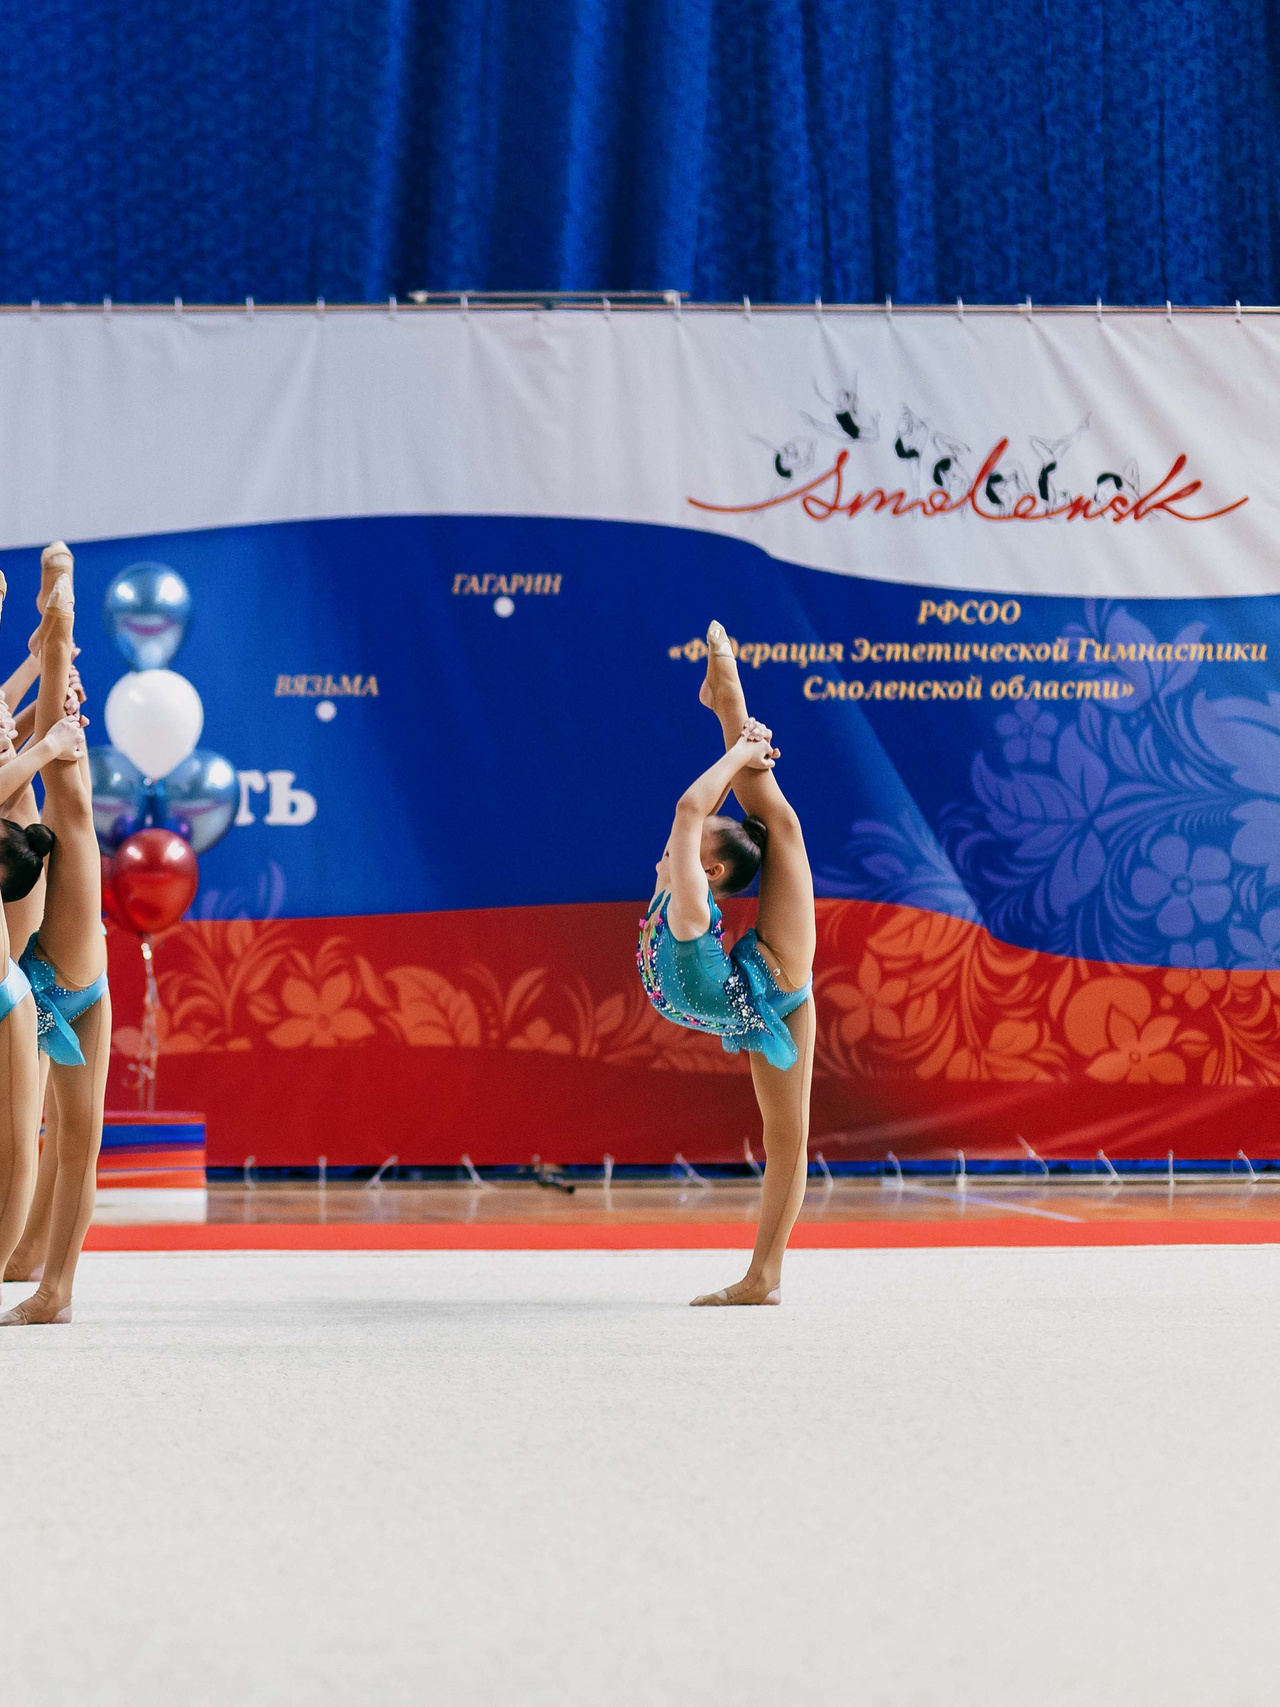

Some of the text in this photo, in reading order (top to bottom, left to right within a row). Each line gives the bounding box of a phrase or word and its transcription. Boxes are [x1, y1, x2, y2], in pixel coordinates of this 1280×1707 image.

[687, 438, 1250, 522] Smolensk
[451, 573, 564, 596] ГАГАРИН
[917, 599, 1021, 625] РФСОО
[668, 636, 1268, 669] «Ферация Эстетической Гимнастики
[274, 674, 380, 698] ВЯЗЬМА
[802, 674, 1135, 701] Смоленской области»
